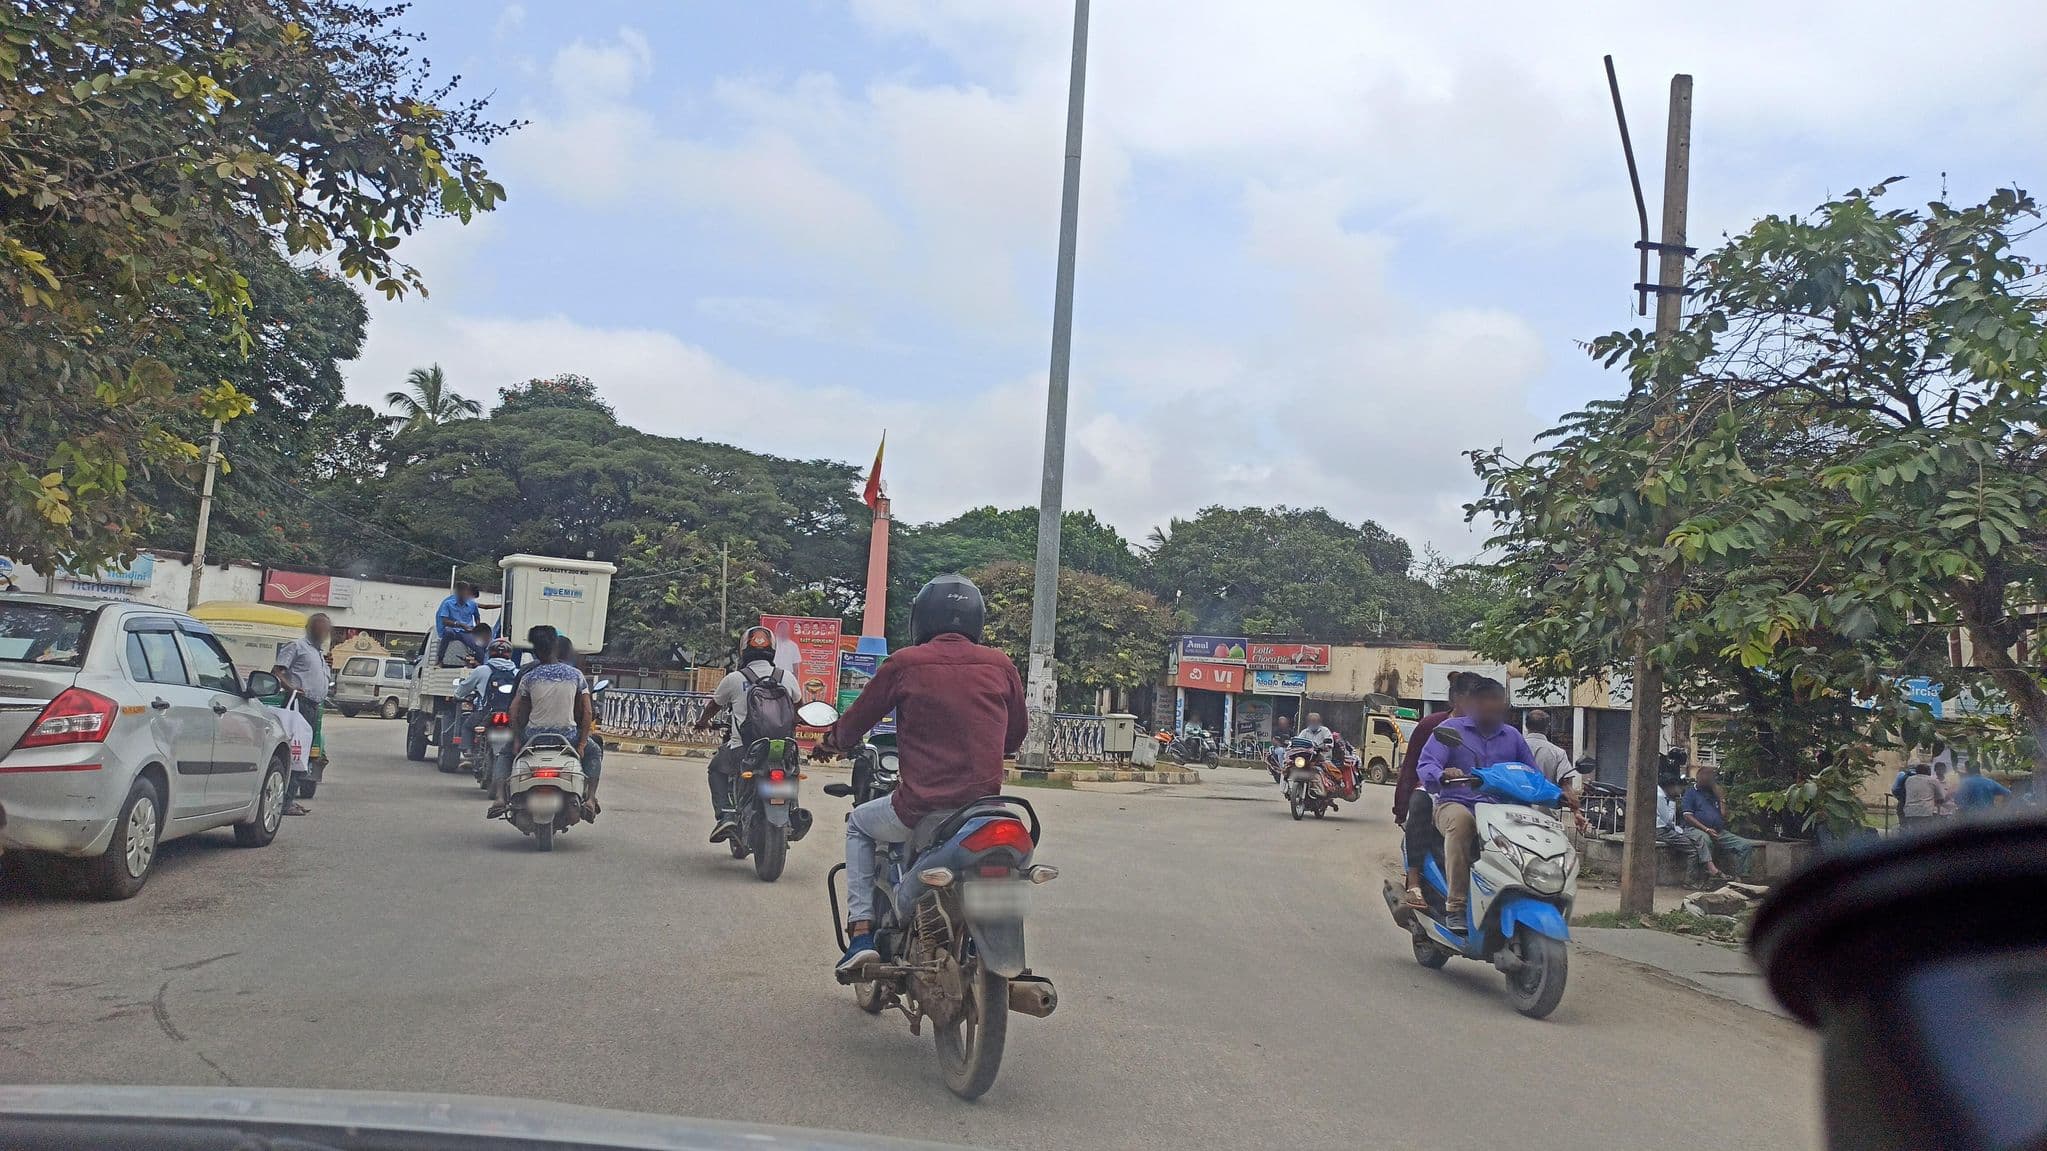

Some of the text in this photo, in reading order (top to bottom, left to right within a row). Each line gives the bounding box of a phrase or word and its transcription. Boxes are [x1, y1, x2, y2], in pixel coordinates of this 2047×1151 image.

[1187, 640, 1209, 650] Amul
[1252, 645, 1274, 654] Lotte
[1905, 685, 1938, 698] ircle
